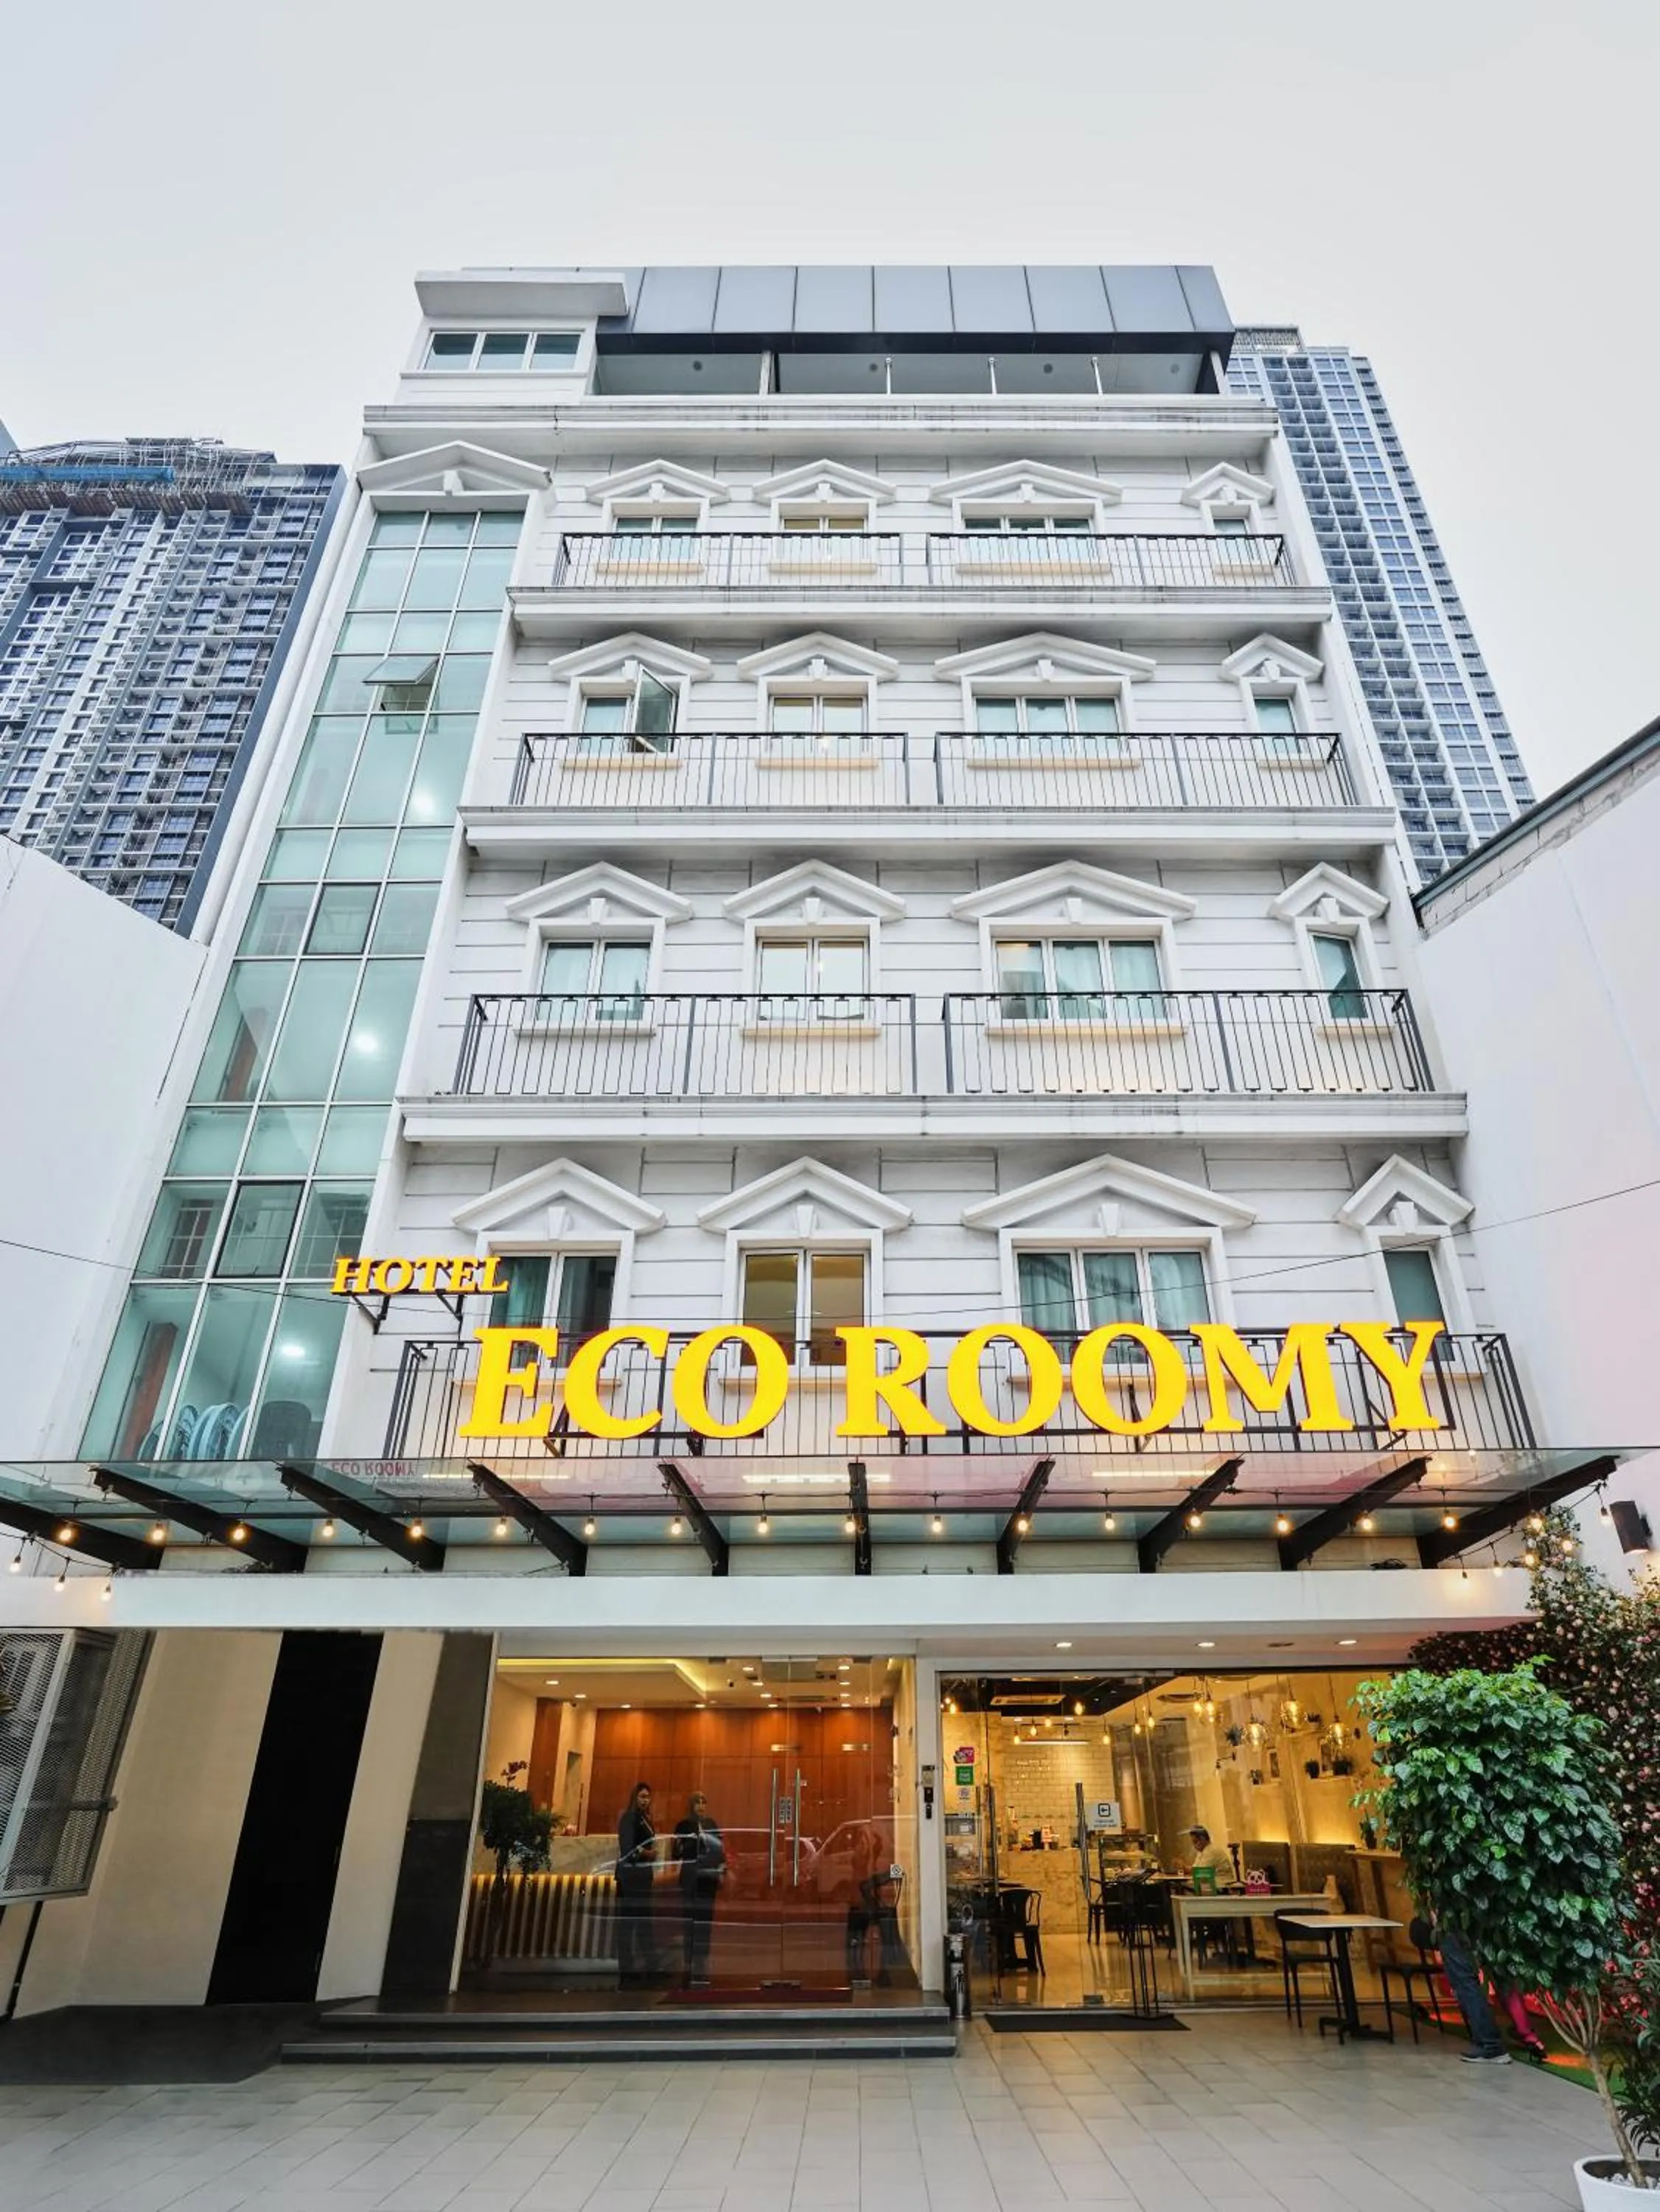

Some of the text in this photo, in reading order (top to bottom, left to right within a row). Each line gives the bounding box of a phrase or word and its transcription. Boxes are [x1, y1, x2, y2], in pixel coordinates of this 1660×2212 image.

[330, 1256, 509, 1295] HOTEL
[459, 1322, 1447, 1439] ECO ROOMY
